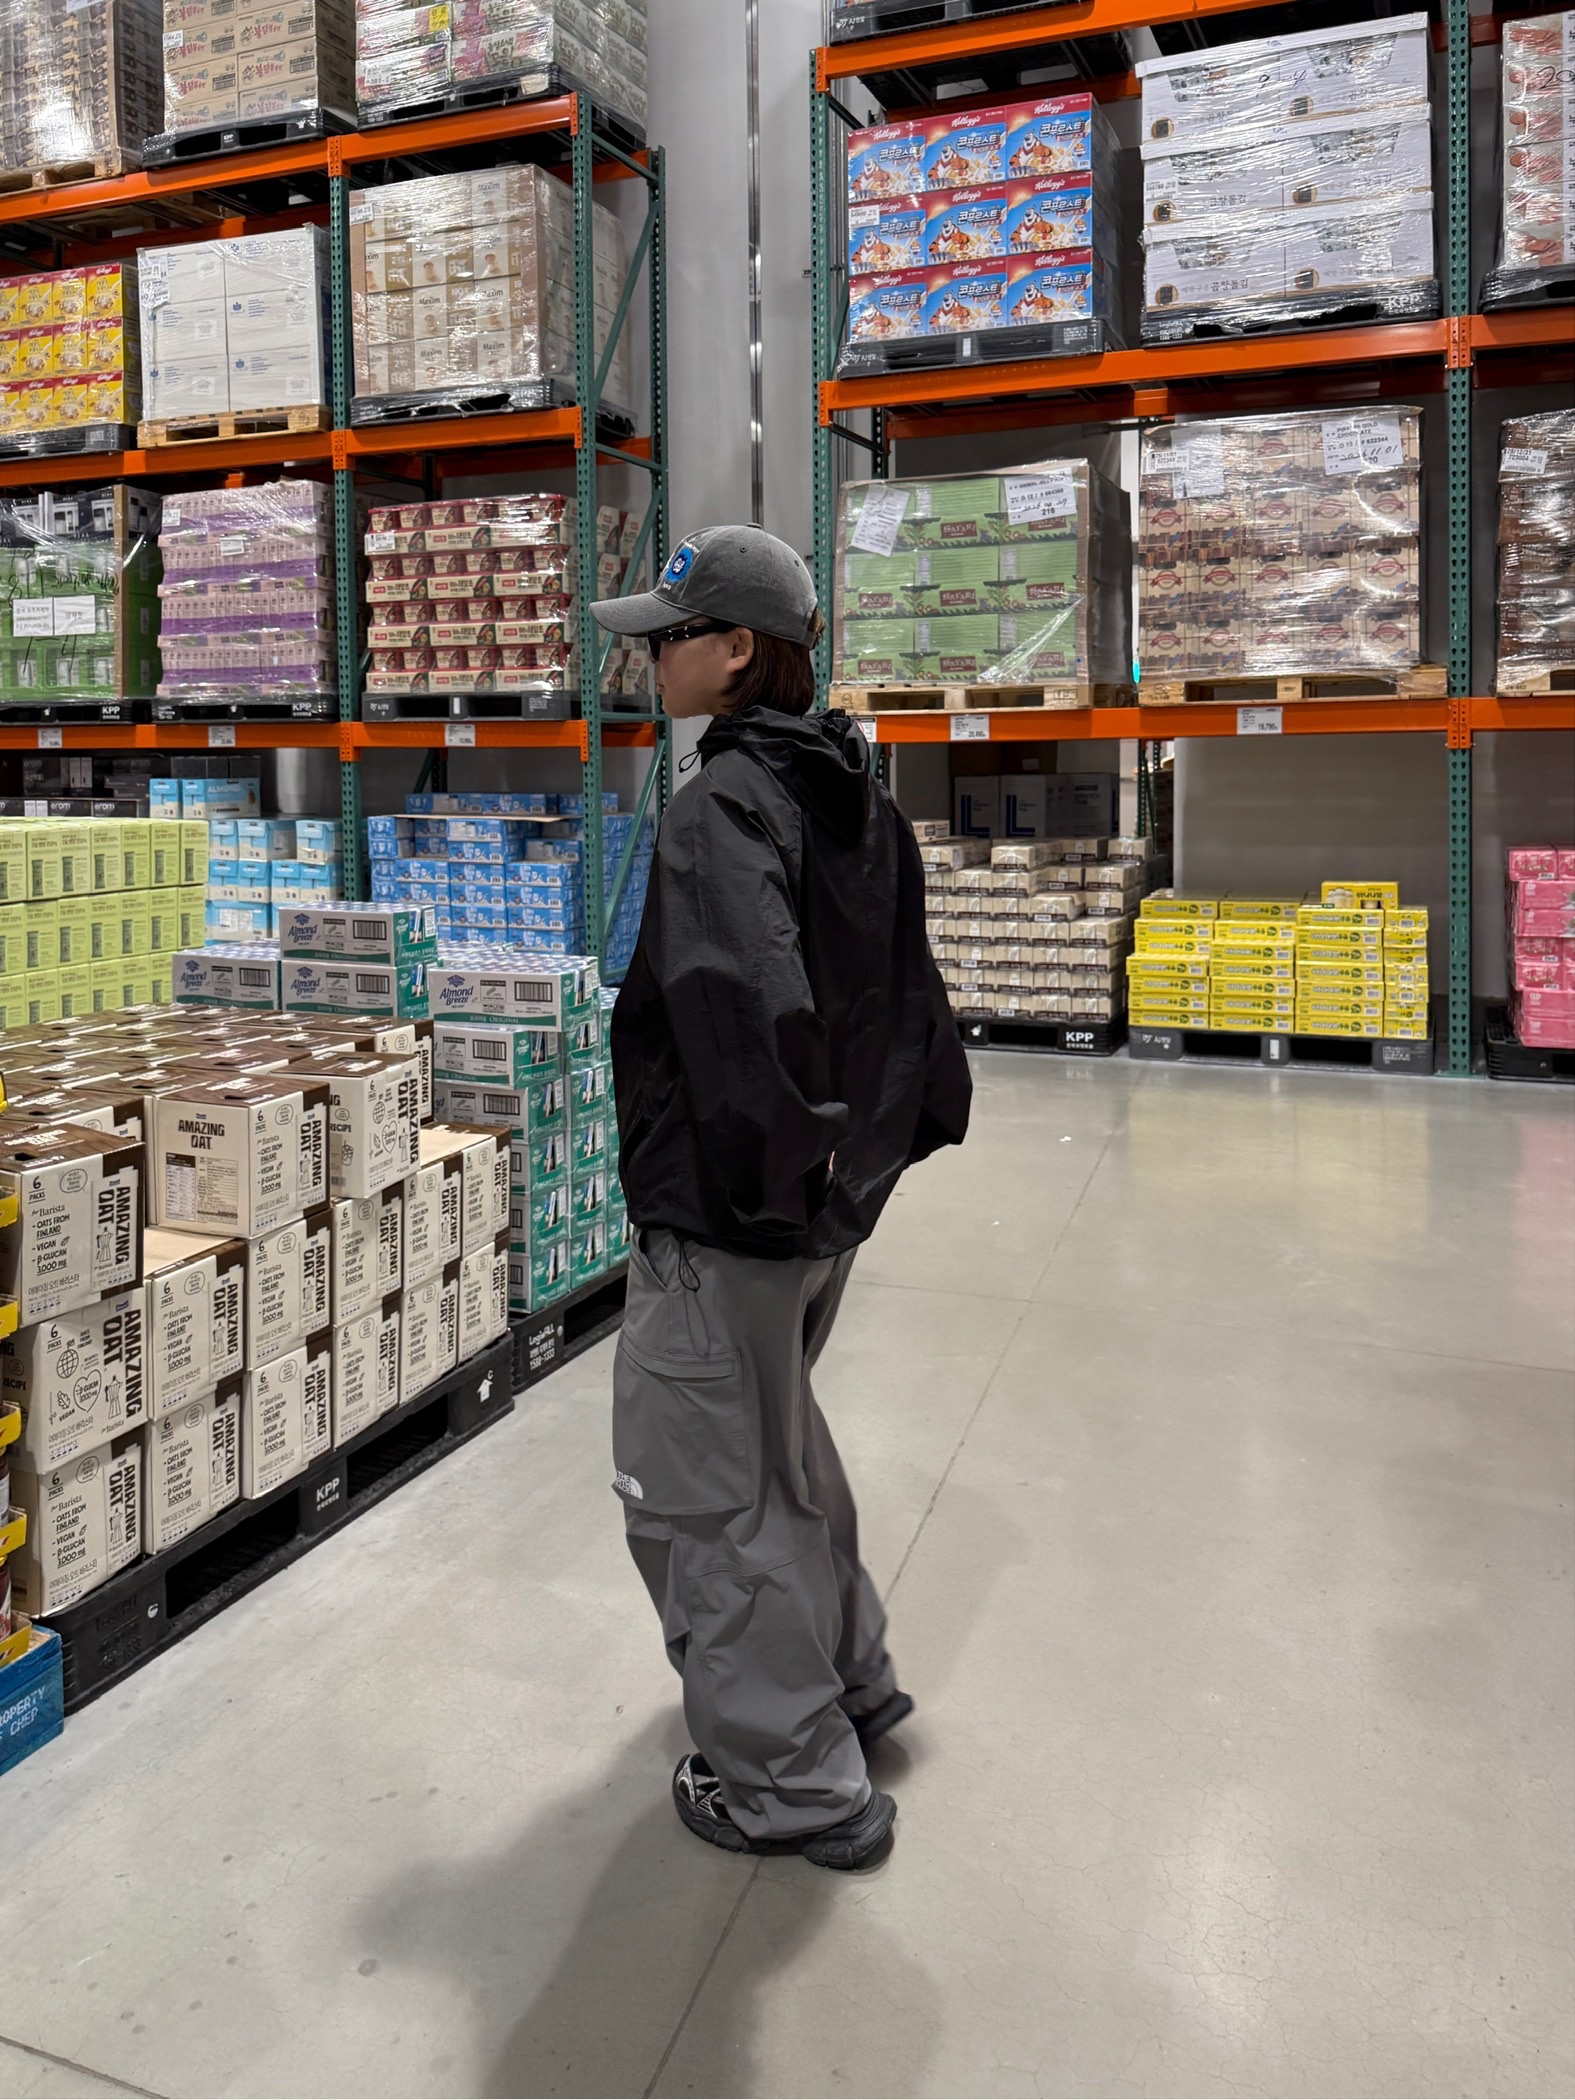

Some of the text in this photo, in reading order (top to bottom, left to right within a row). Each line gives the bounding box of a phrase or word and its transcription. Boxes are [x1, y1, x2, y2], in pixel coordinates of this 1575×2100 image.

[1034, 102, 1065, 115] Kellogg's
[951, 115, 981, 128] Kellogg's
[1035, 178, 1066, 191] Kellogg's
[952, 190, 981, 203] Kellogg's
[1035, 254, 1066, 267] Kellogg's
[1337, 429, 1372, 438] CHOCOATE
[942, 592, 976, 602] SAFARI
[102, 705, 120, 715] KPP
[292, 702, 312, 711] KPP
[50, 801, 71, 811] erom
[94, 802, 115, 812] erom
[288, 925, 318, 938] Almond
[180, 971, 207, 983] Almond
[290, 978, 321, 990] Almond
[439, 986, 474, 1001] Almond
[1065, 1031, 1094, 1043] KPP
[398, 1080, 409, 1120] OAT
[257, 1110, 264, 1122] 6
[408, 1078, 419, 1165] AMAZING
[178, 1119, 225, 1137] AMAZING
[191, 1136, 213, 1150] OAT
[300, 1122, 312, 1152] OAT
[312, 1120, 322, 1187] AMAZING
[33, 1175, 42, 1189] 6
[39, 1205, 66, 1217] Barista
[97, 1189, 115, 1226] OAT
[36, 1214, 70, 1229] OATS FROM
[450, 1186, 458, 1245] AMAZING
[36, 1225, 62, 1238] FINLAND
[115, 1186, 131, 1266] AMAZING
[36, 1240, 57, 1252] VEGAN
[258, 1240, 265, 1252] 6
[389, 1212, 398, 1275] AMAZING
[303, 1247, 315, 1279] OAT
[315, 1245, 326, 1313] AMAZING
[164, 1281, 171, 1294] 6
[213, 1287, 226, 1320] OAT
[227, 1283, 238, 1356] AMAZING
[50, 1324, 59, 1338] 6
[103, 1315, 123, 1366] OAT
[124, 1309, 142, 1419] AMAZING
[259, 1371, 267, 1384] 6
[304, 1373, 316, 1405] OAT
[316, 1369, 327, 1438] AMAZING
[164, 1417, 171, 1430] 6
[212, 1418, 225, 1451] OAT
[225, 1412, 236, 1486] AMAZING
[51, 1472, 60, 1486] 6
[109, 1470, 124, 1507] OAT
[316, 1477, 340, 1503] KPP
[123, 1464, 137, 1543] AMAZING
[56, 1502, 87, 1524] OATS FROM
[56, 1515, 80, 1532] FINLAND
[56, 1530, 76, 1547] VEGAN
[0, 1686, 45, 1727] ROPERTY
